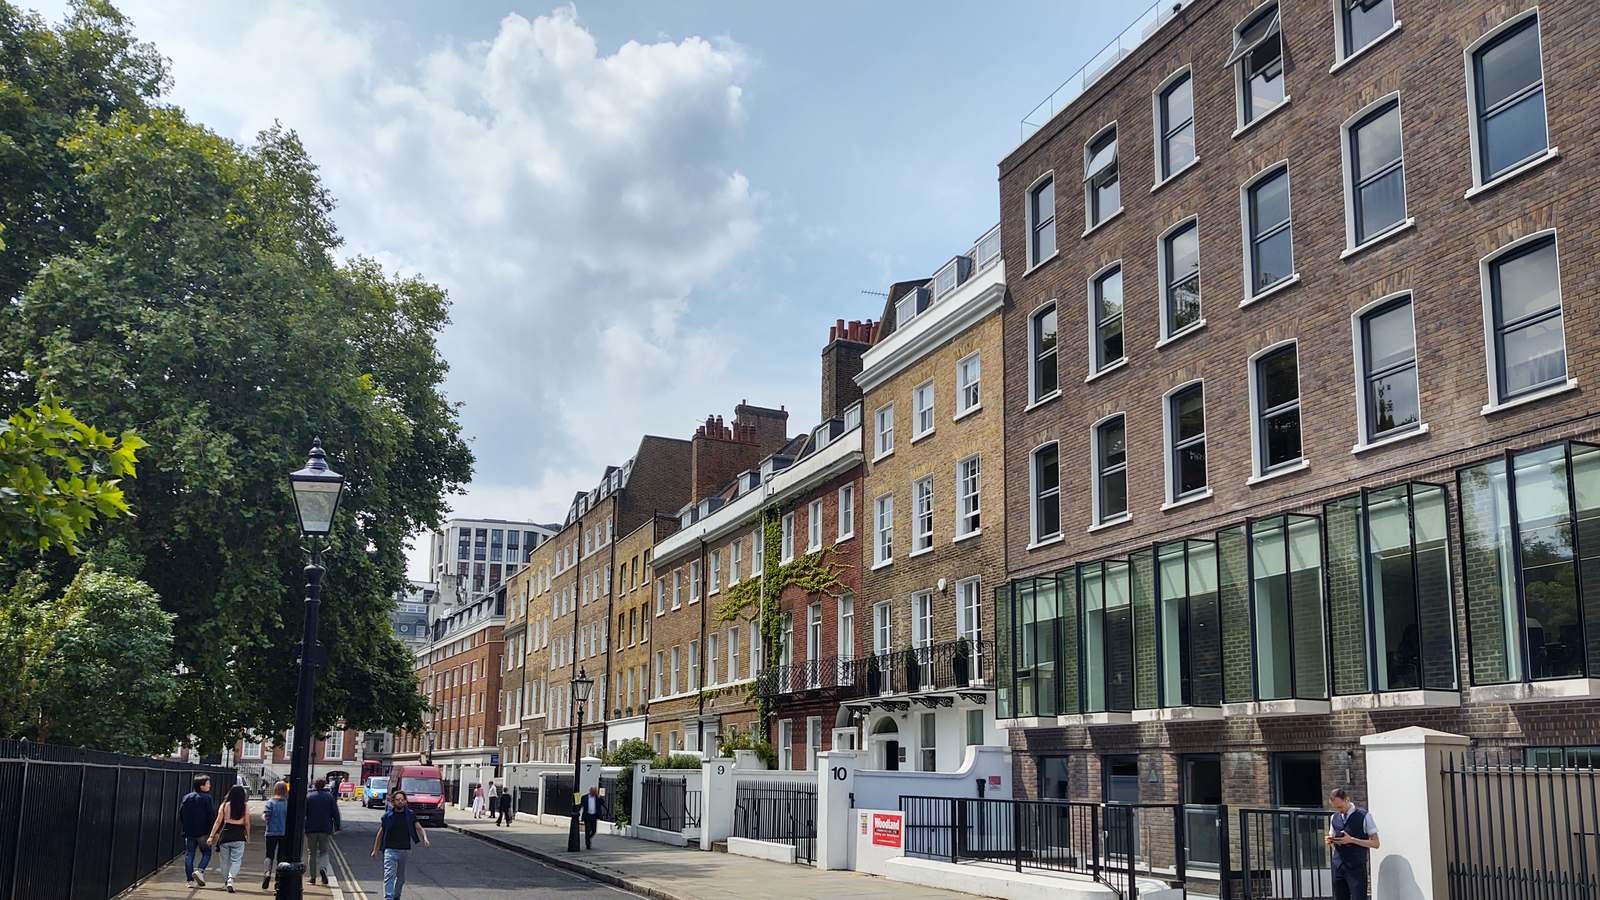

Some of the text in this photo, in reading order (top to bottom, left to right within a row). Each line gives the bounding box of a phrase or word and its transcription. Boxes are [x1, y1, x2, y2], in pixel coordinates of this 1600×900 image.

[641, 764, 646, 773] 8
[717, 765, 725, 775] 9
[832, 766, 847, 780] 10
[874, 817, 900, 830] Woodland
